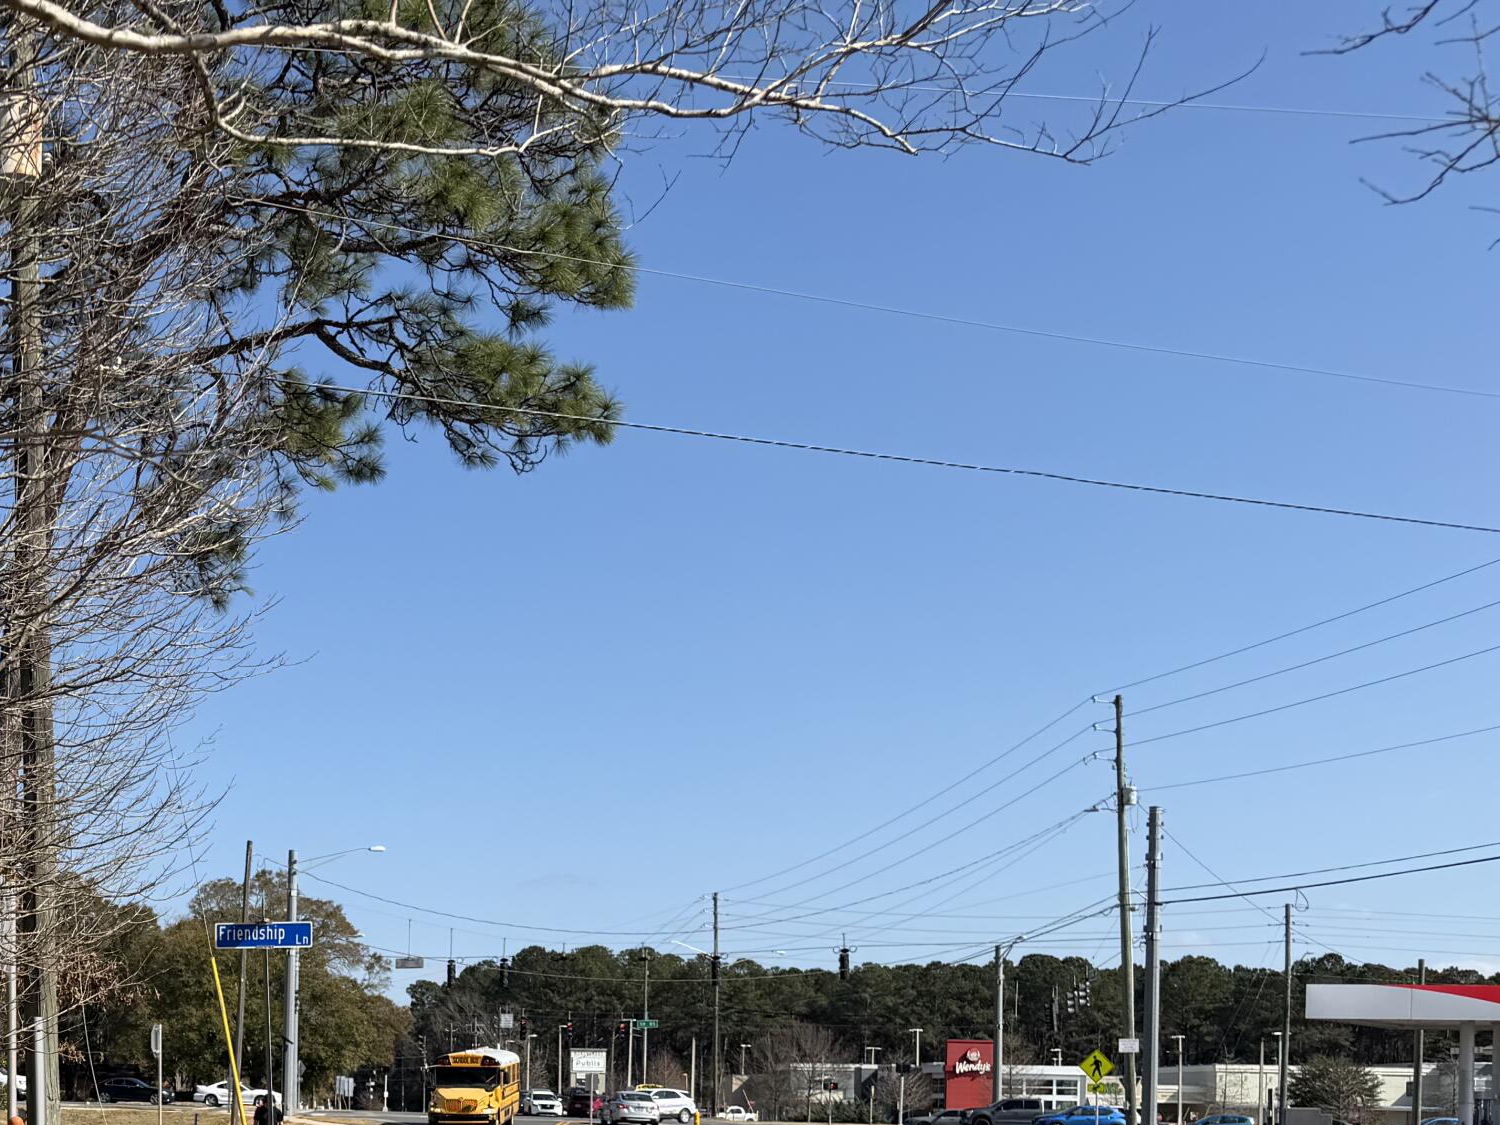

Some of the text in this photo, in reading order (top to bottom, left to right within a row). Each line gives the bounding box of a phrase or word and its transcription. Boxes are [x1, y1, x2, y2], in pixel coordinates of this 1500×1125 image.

[219, 925, 308, 945] Friendship Ln
[452, 1056, 479, 1064] SCHOOL BUS
[955, 1060, 991, 1074] Wendy's
